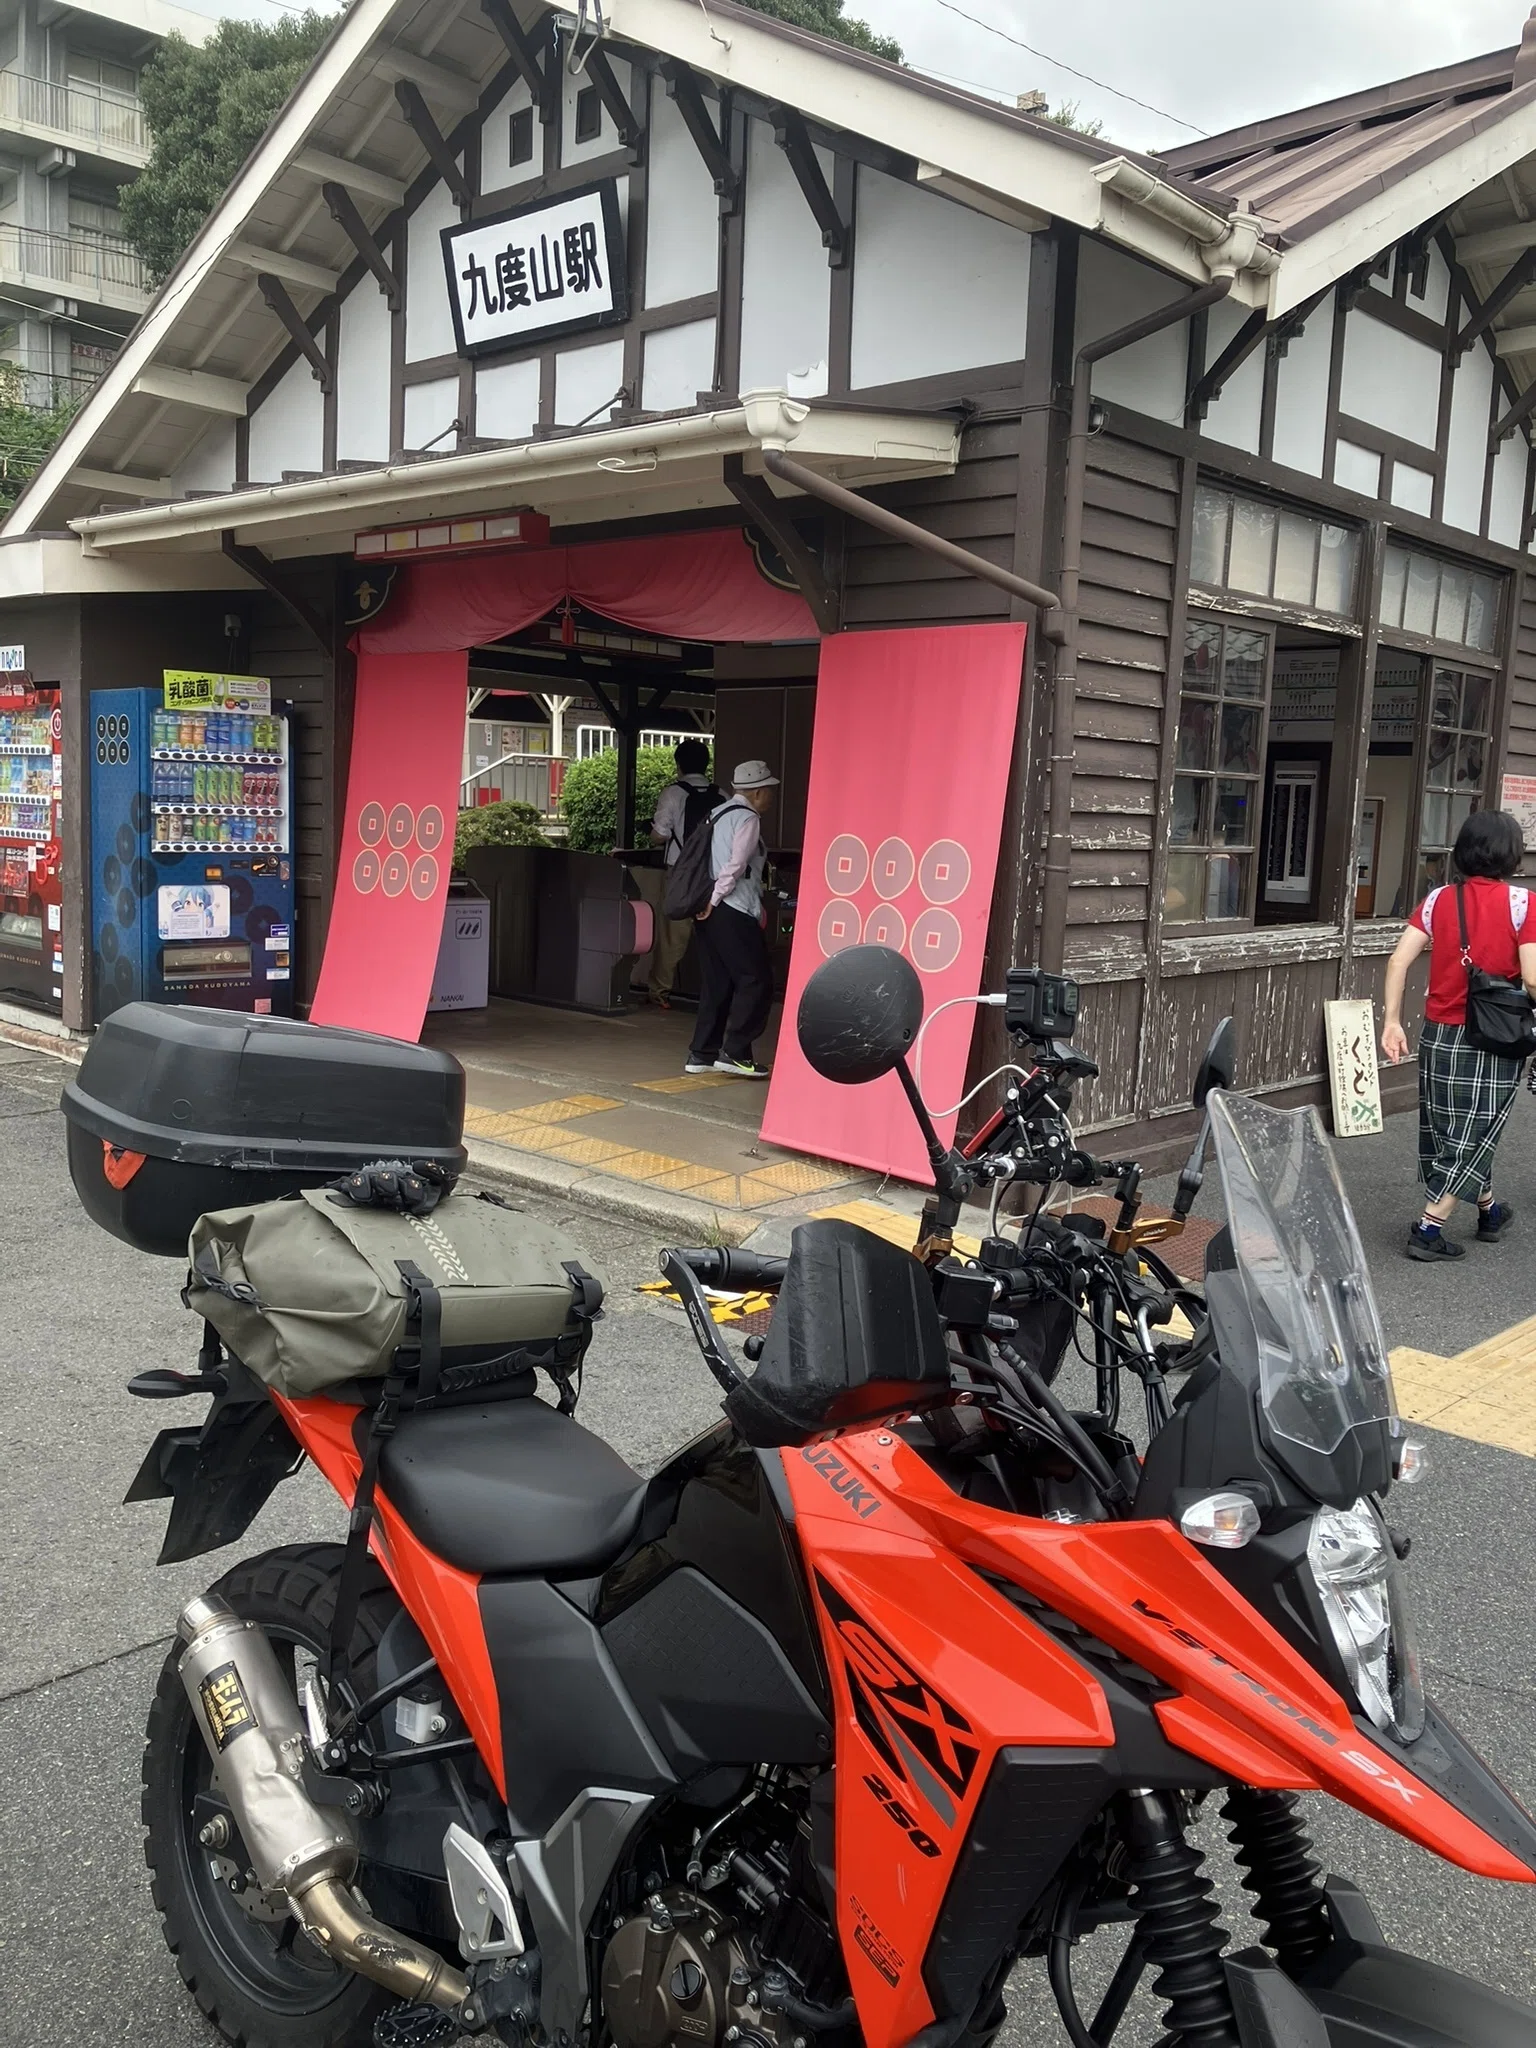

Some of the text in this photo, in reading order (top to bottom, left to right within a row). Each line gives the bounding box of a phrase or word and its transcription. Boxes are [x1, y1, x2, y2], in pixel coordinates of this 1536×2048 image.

[462, 222, 603, 320] 九度山駅
[169, 679, 209, 700] 乳酸菌
[802, 1446, 882, 1519] UZUKI
[211, 1673, 248, 1727] ヨシムラ
[838, 1620, 982, 1783] SX
[1131, 1598, 1341, 1747] V-STROM
[1339, 1750, 1425, 1806] SX
[862, 1773, 942, 1858] 250
[849, 1894, 906, 1968] SOCS
